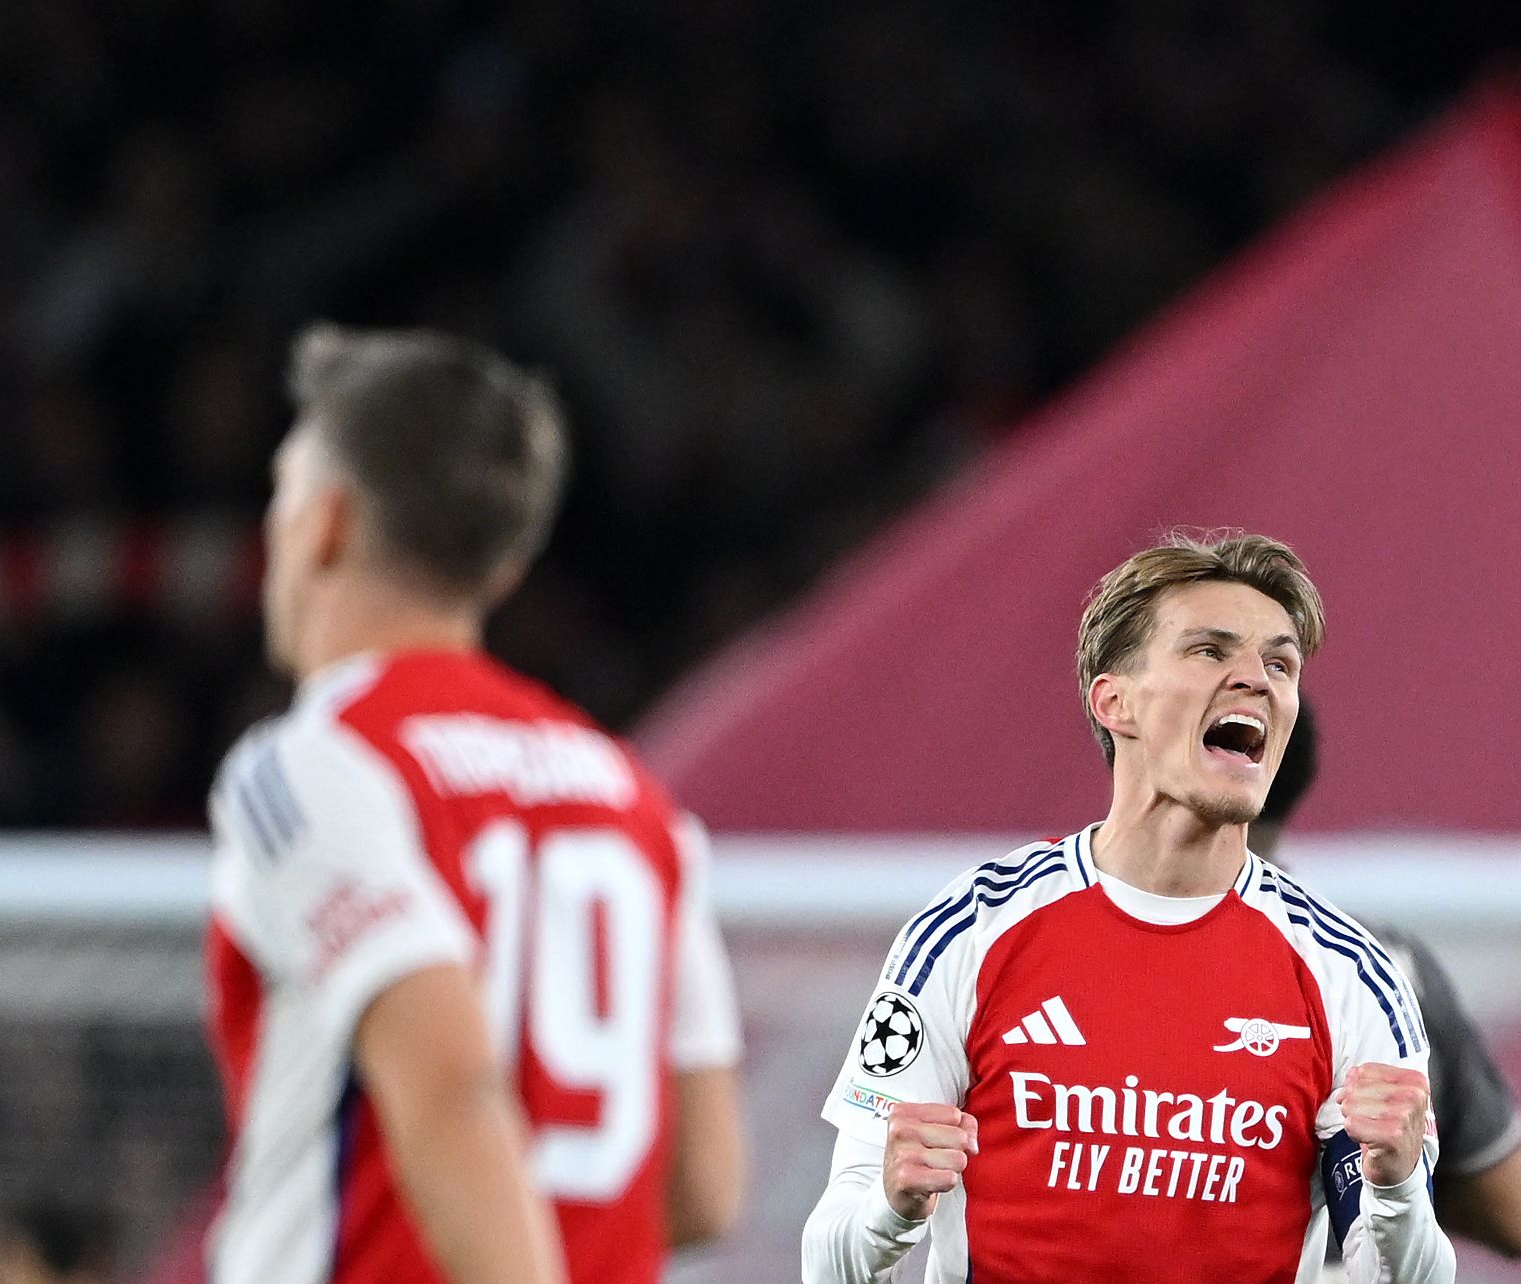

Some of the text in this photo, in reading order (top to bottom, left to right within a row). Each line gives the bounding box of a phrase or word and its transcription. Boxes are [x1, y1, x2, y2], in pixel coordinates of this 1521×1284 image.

[460, 814, 665, 1206] 19
[1008, 1070, 1289, 1151] Emirates
[1047, 1141, 1246, 1204] FLY BETTER
